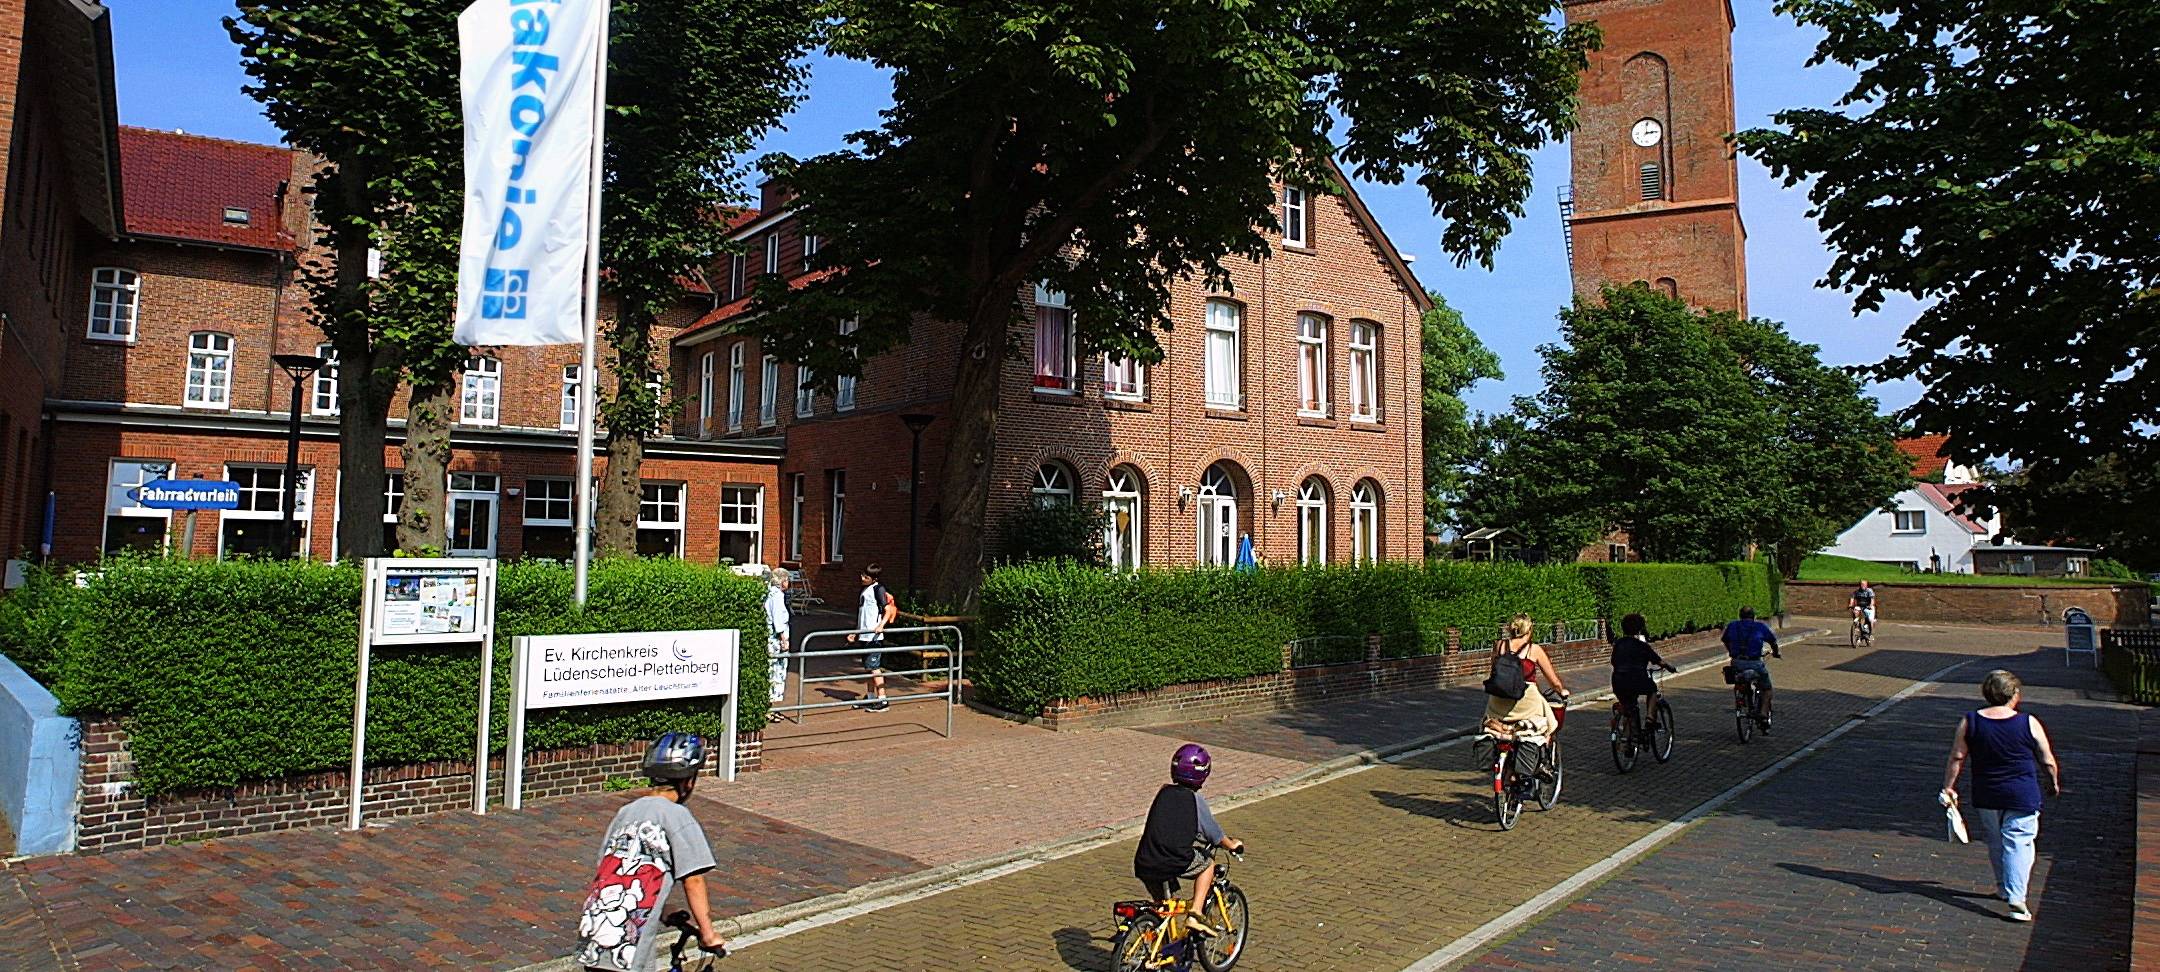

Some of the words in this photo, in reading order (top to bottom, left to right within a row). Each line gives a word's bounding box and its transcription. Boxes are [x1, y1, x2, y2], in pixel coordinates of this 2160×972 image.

[140, 487, 238, 502] Fahrradverleih
[545, 648, 565, 663] Ev.
[571, 645, 659, 661] Kirchenkreis
[544, 661, 719, 682] Lüdenscheid-Plettenberg
